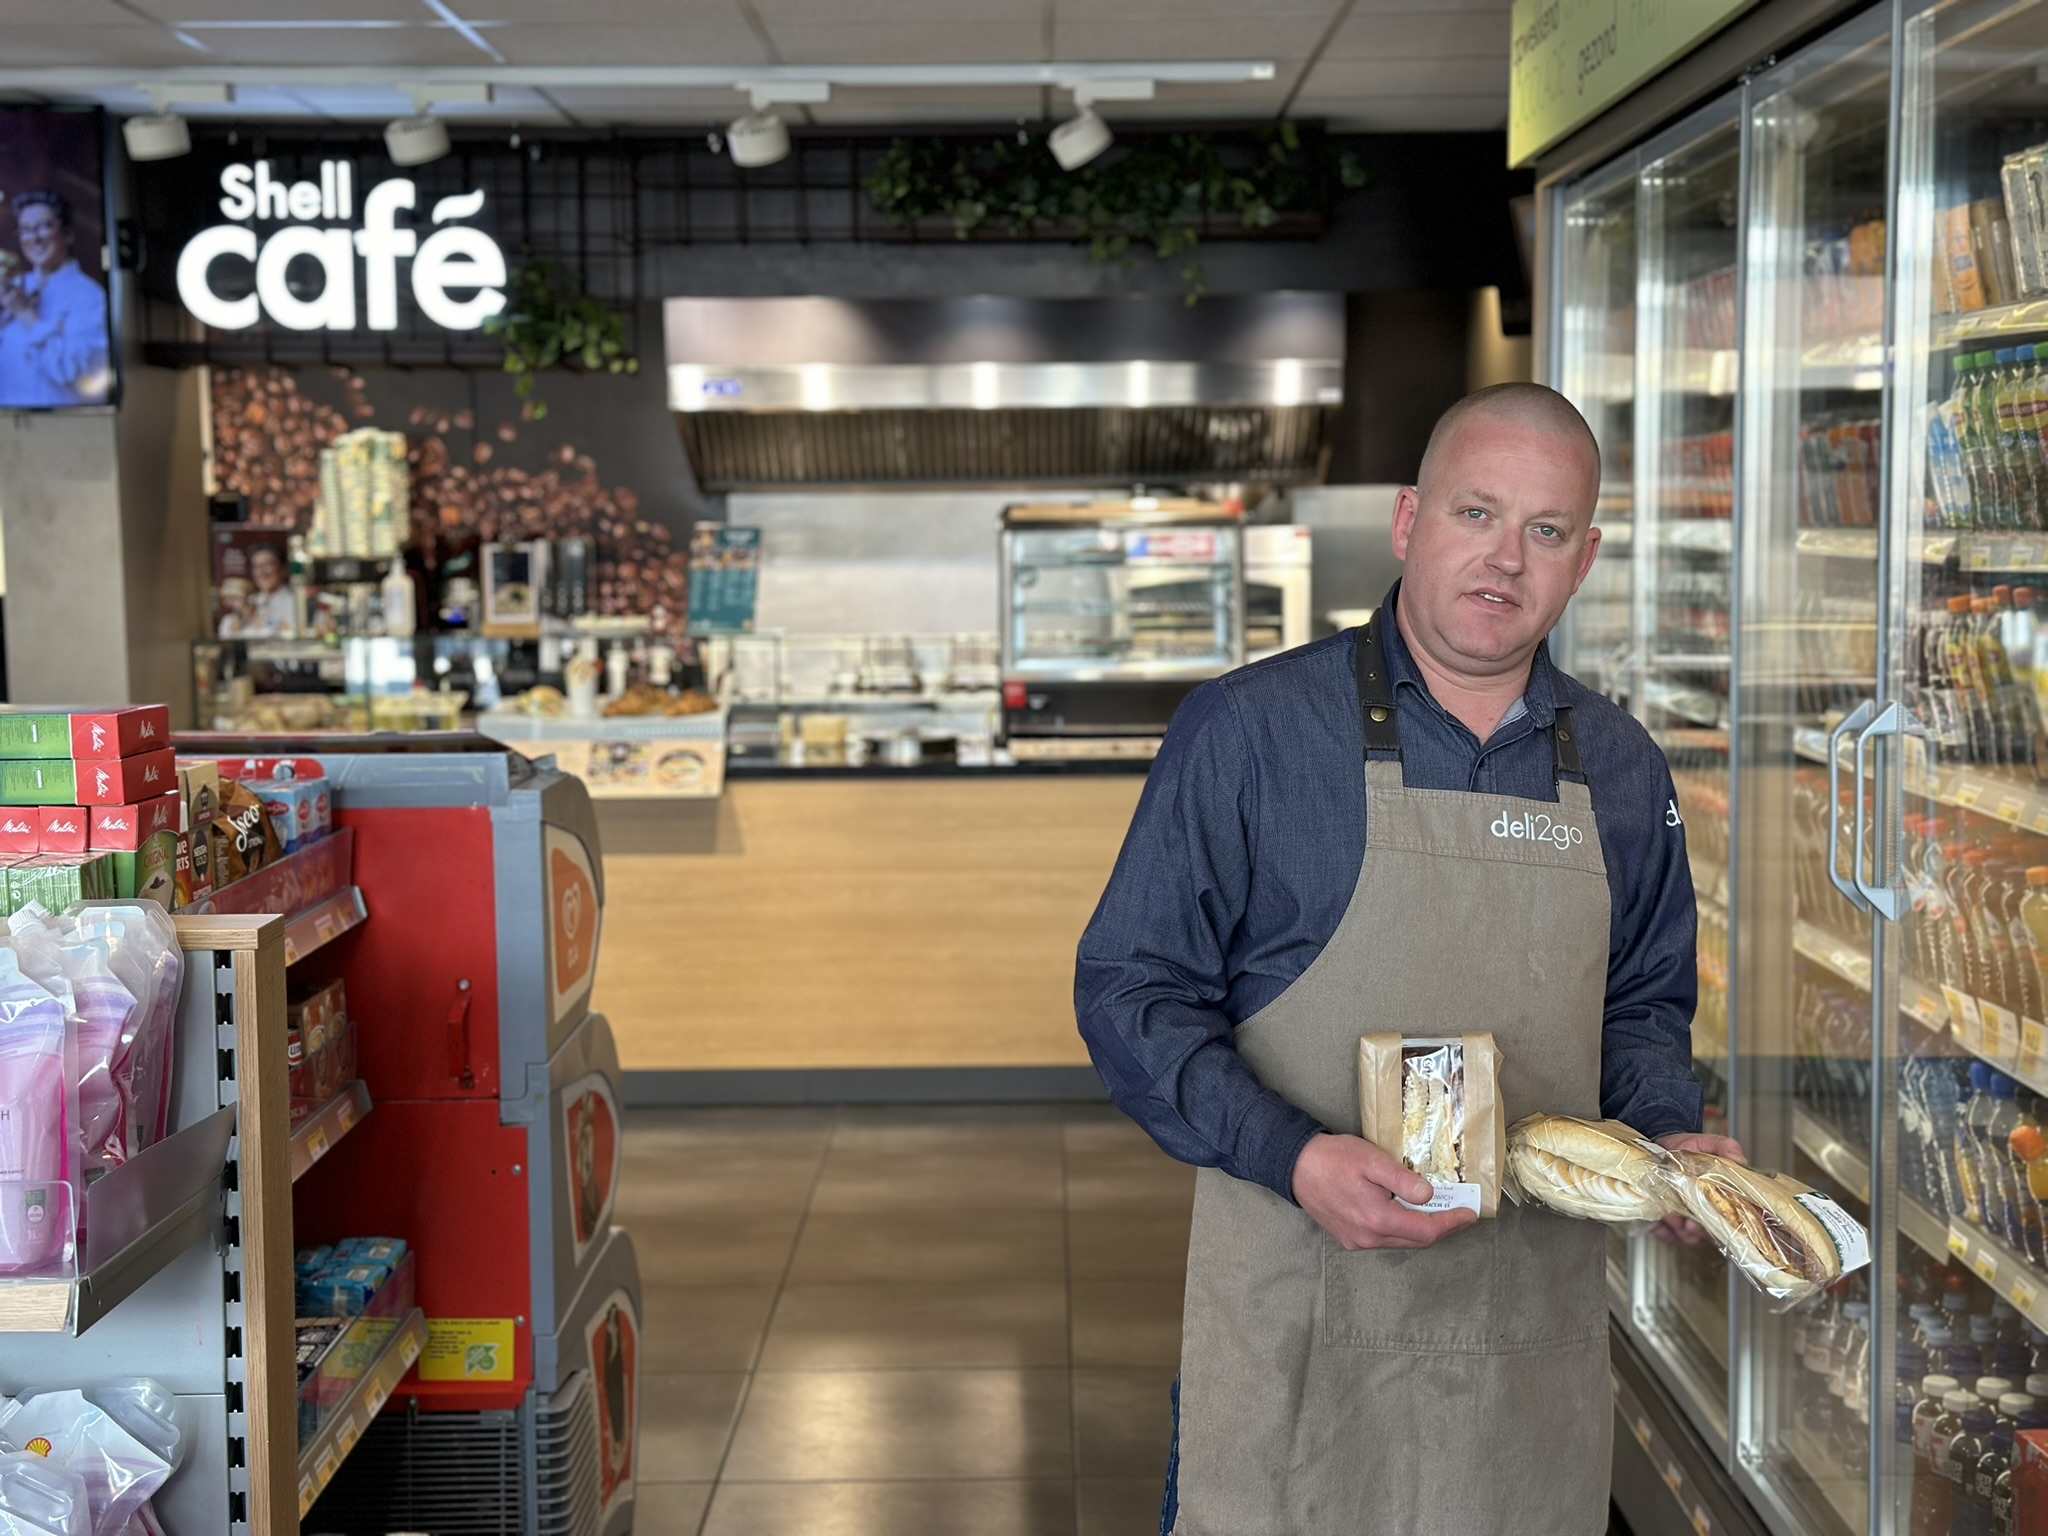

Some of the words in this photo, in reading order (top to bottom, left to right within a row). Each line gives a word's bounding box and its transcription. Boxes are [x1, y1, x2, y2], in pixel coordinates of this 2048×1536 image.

[219, 159, 352, 221] Shell
[176, 178, 507, 331] café
[89, 720, 106, 752] Melitta
[94, 766, 111, 798] Melitta
[0, 818, 32, 834] Melitta
[46, 818, 78, 834] Melitta
[97, 815, 129, 831] Melitta
[1490, 810, 1583, 850] deli2go
